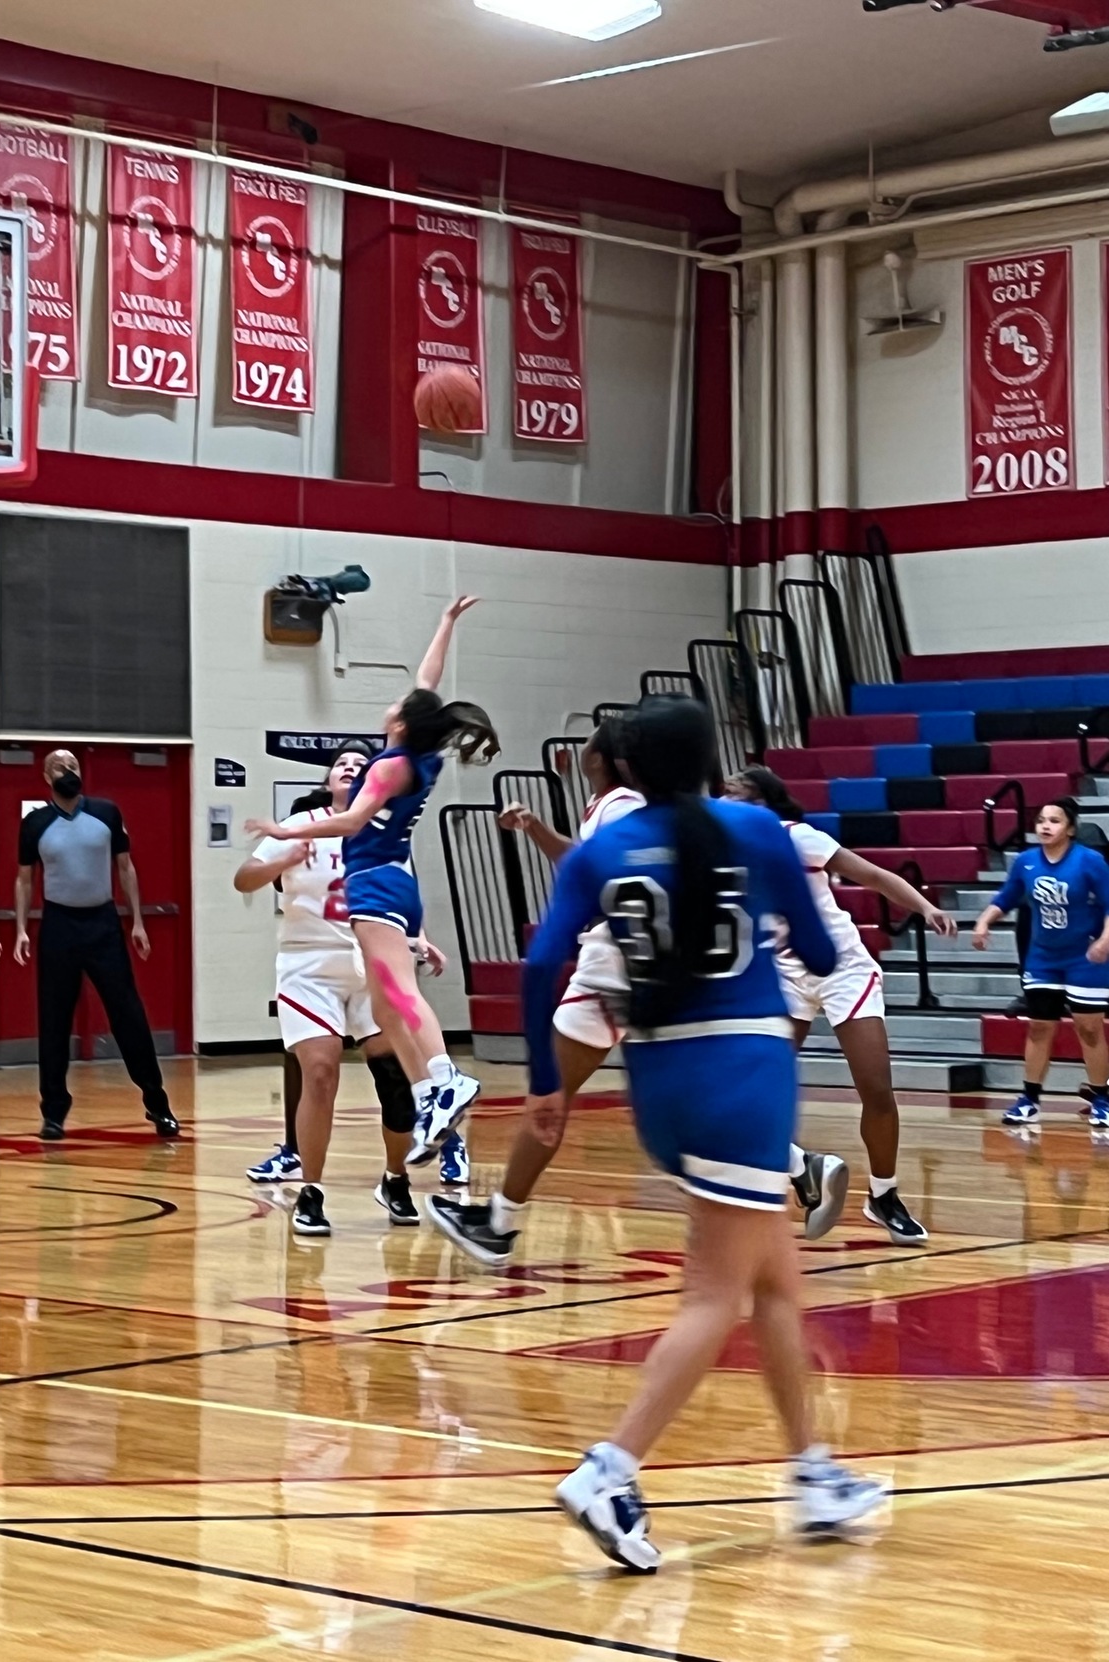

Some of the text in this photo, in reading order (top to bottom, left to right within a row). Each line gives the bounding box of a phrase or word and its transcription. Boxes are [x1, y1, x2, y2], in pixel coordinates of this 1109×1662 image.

[124, 156, 179, 184] TENNIS
[417, 214, 477, 240] OLLEYBALL
[988, 259, 1045, 283] MEN'S
[993, 281, 1041, 303] GOLF
[26, 331, 70, 373] 75
[115, 344, 189, 389] 1972
[237, 360, 307, 404] 1974
[519, 398, 579, 436] 1979
[972, 446, 1068, 493] 2008
